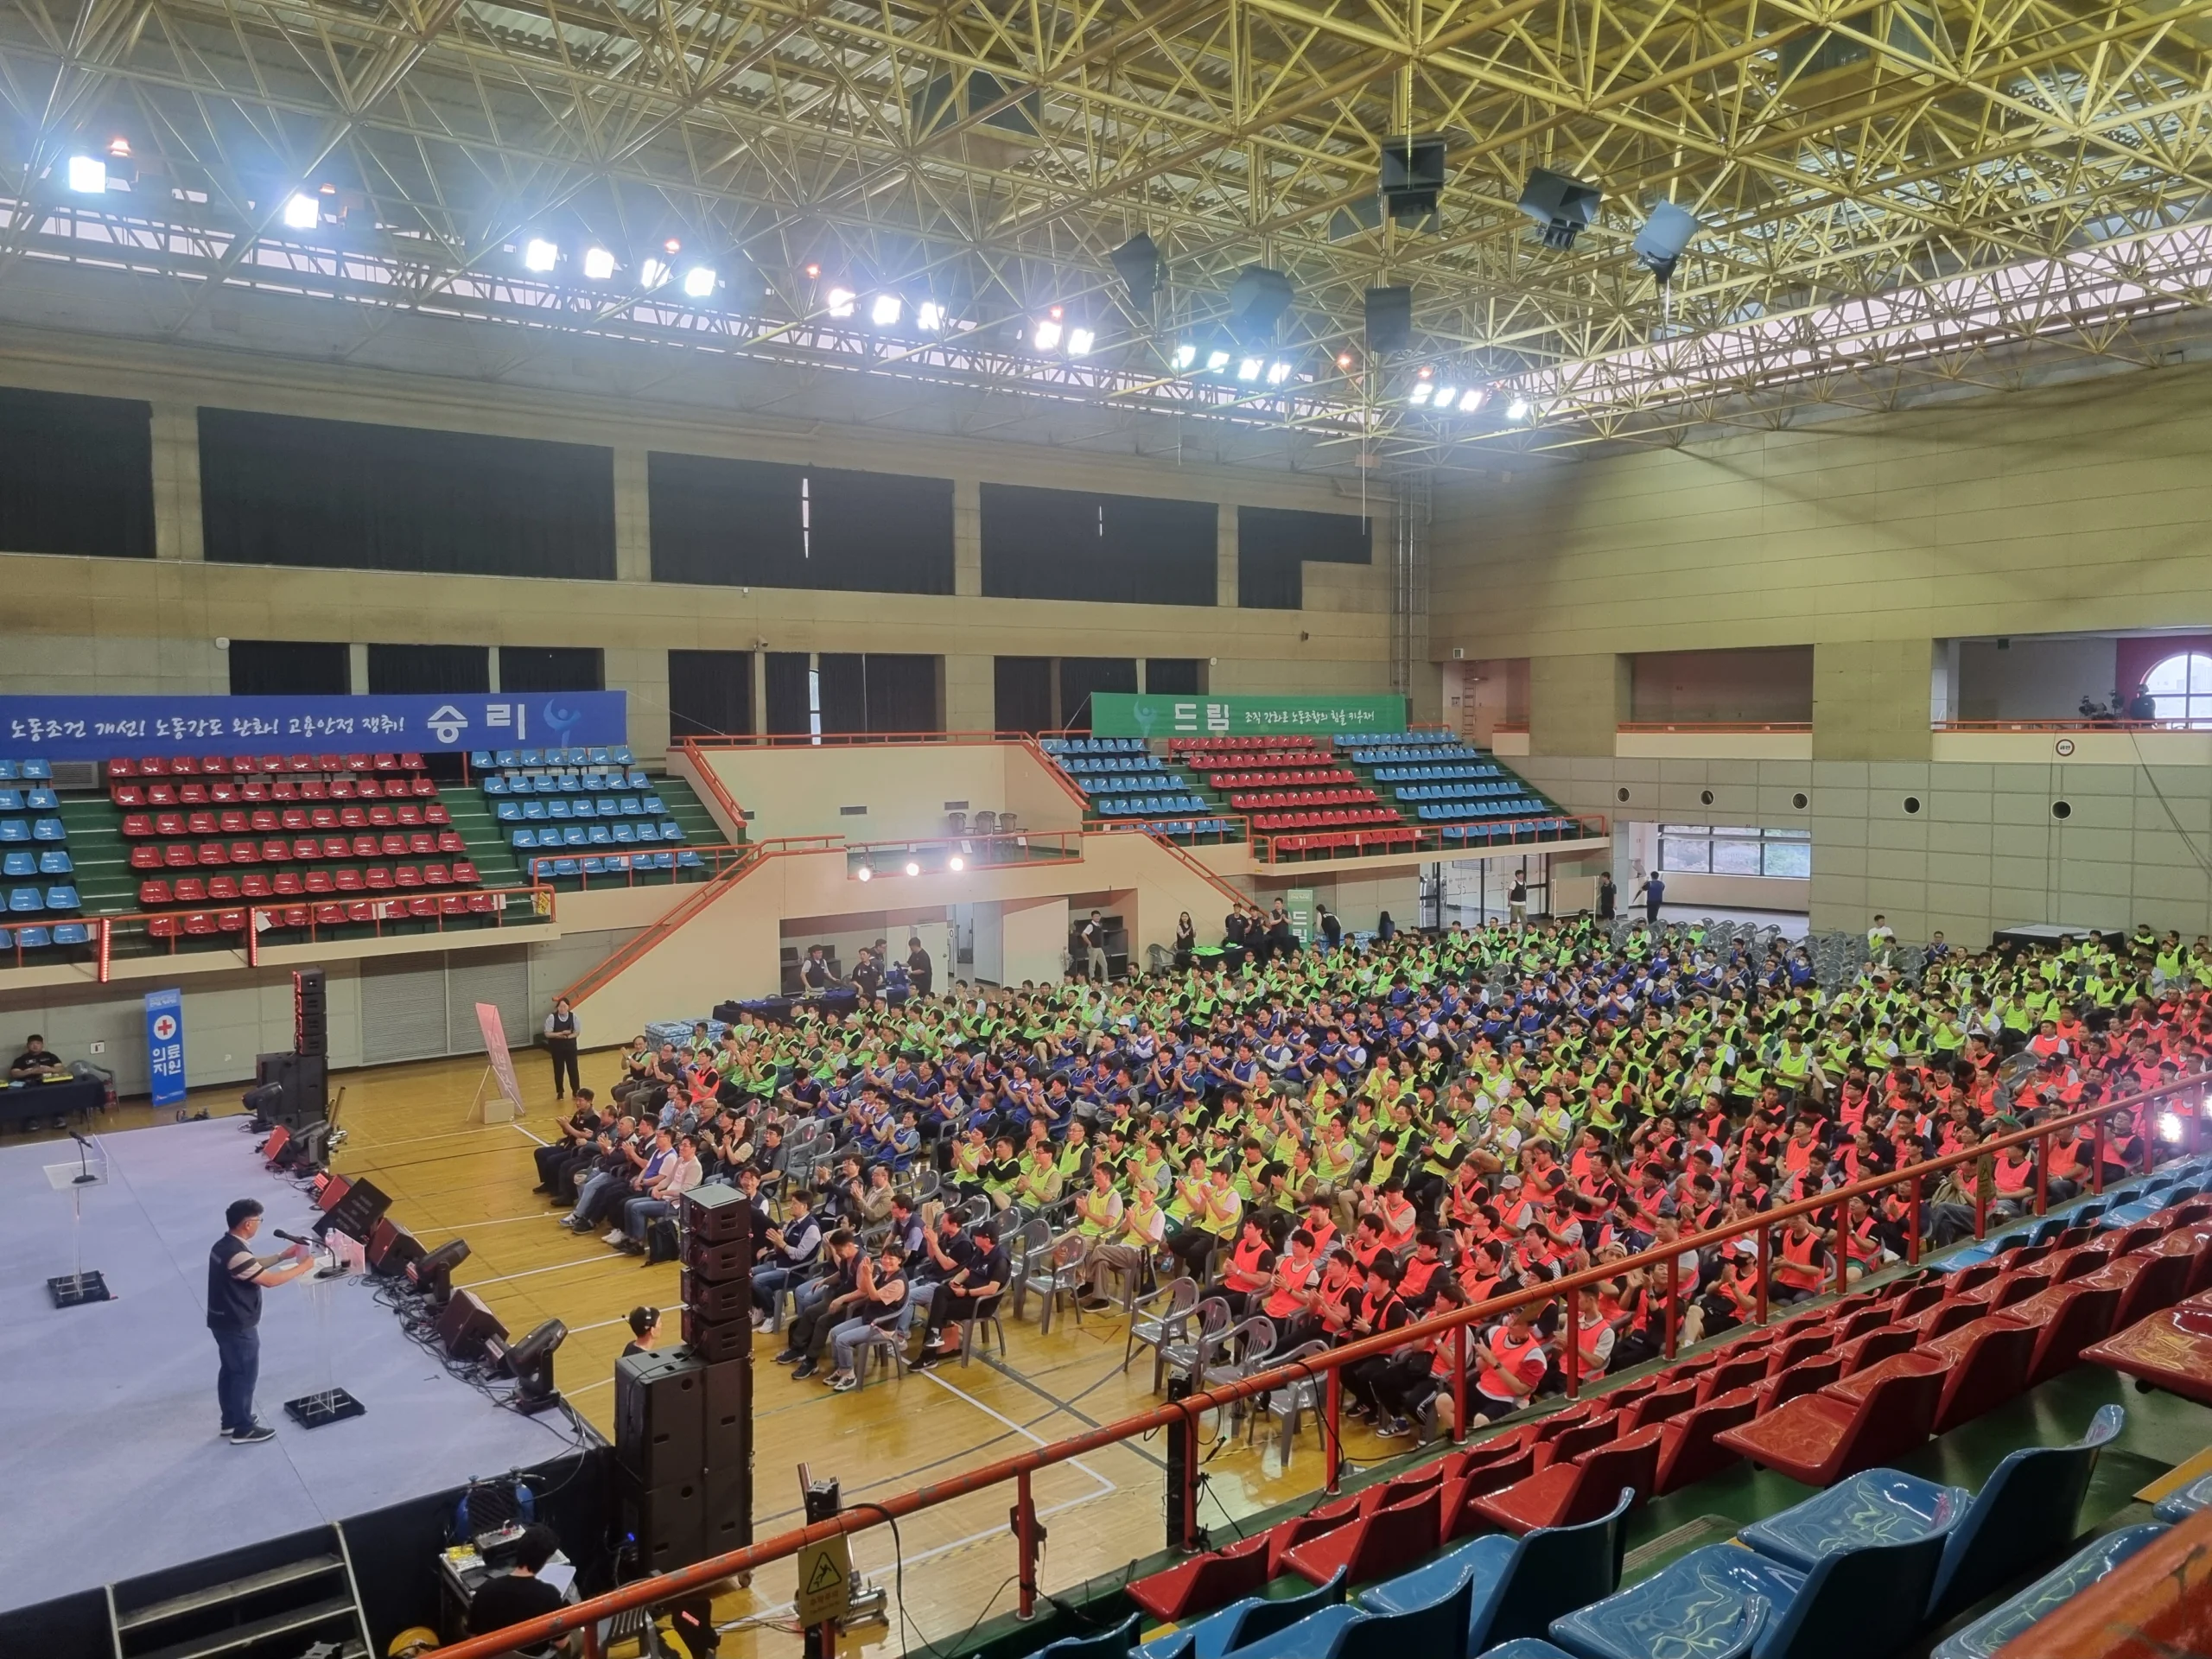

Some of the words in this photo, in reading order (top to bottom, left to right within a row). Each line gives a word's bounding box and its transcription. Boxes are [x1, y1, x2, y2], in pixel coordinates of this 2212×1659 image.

[1245, 710, 1262, 725] 조직
[1264, 710, 1289, 724] 강화로
[1292, 709, 1328, 726] 노동조합의
[1331, 709, 1347, 727] 힘을
[1349, 709, 1375, 724] 키우자!
[11, 717, 86, 742] 노동조건
[94, 720, 145, 737] 개선!
[156, 717, 223, 741] 노동강도
[232, 717, 279, 736] 완화!
[289, 715, 354, 738] 고용안정
[362, 714, 405, 734] 쟁취!
[152, 1044, 181, 1064] 의료
[153, 1059, 181, 1077] 지원
